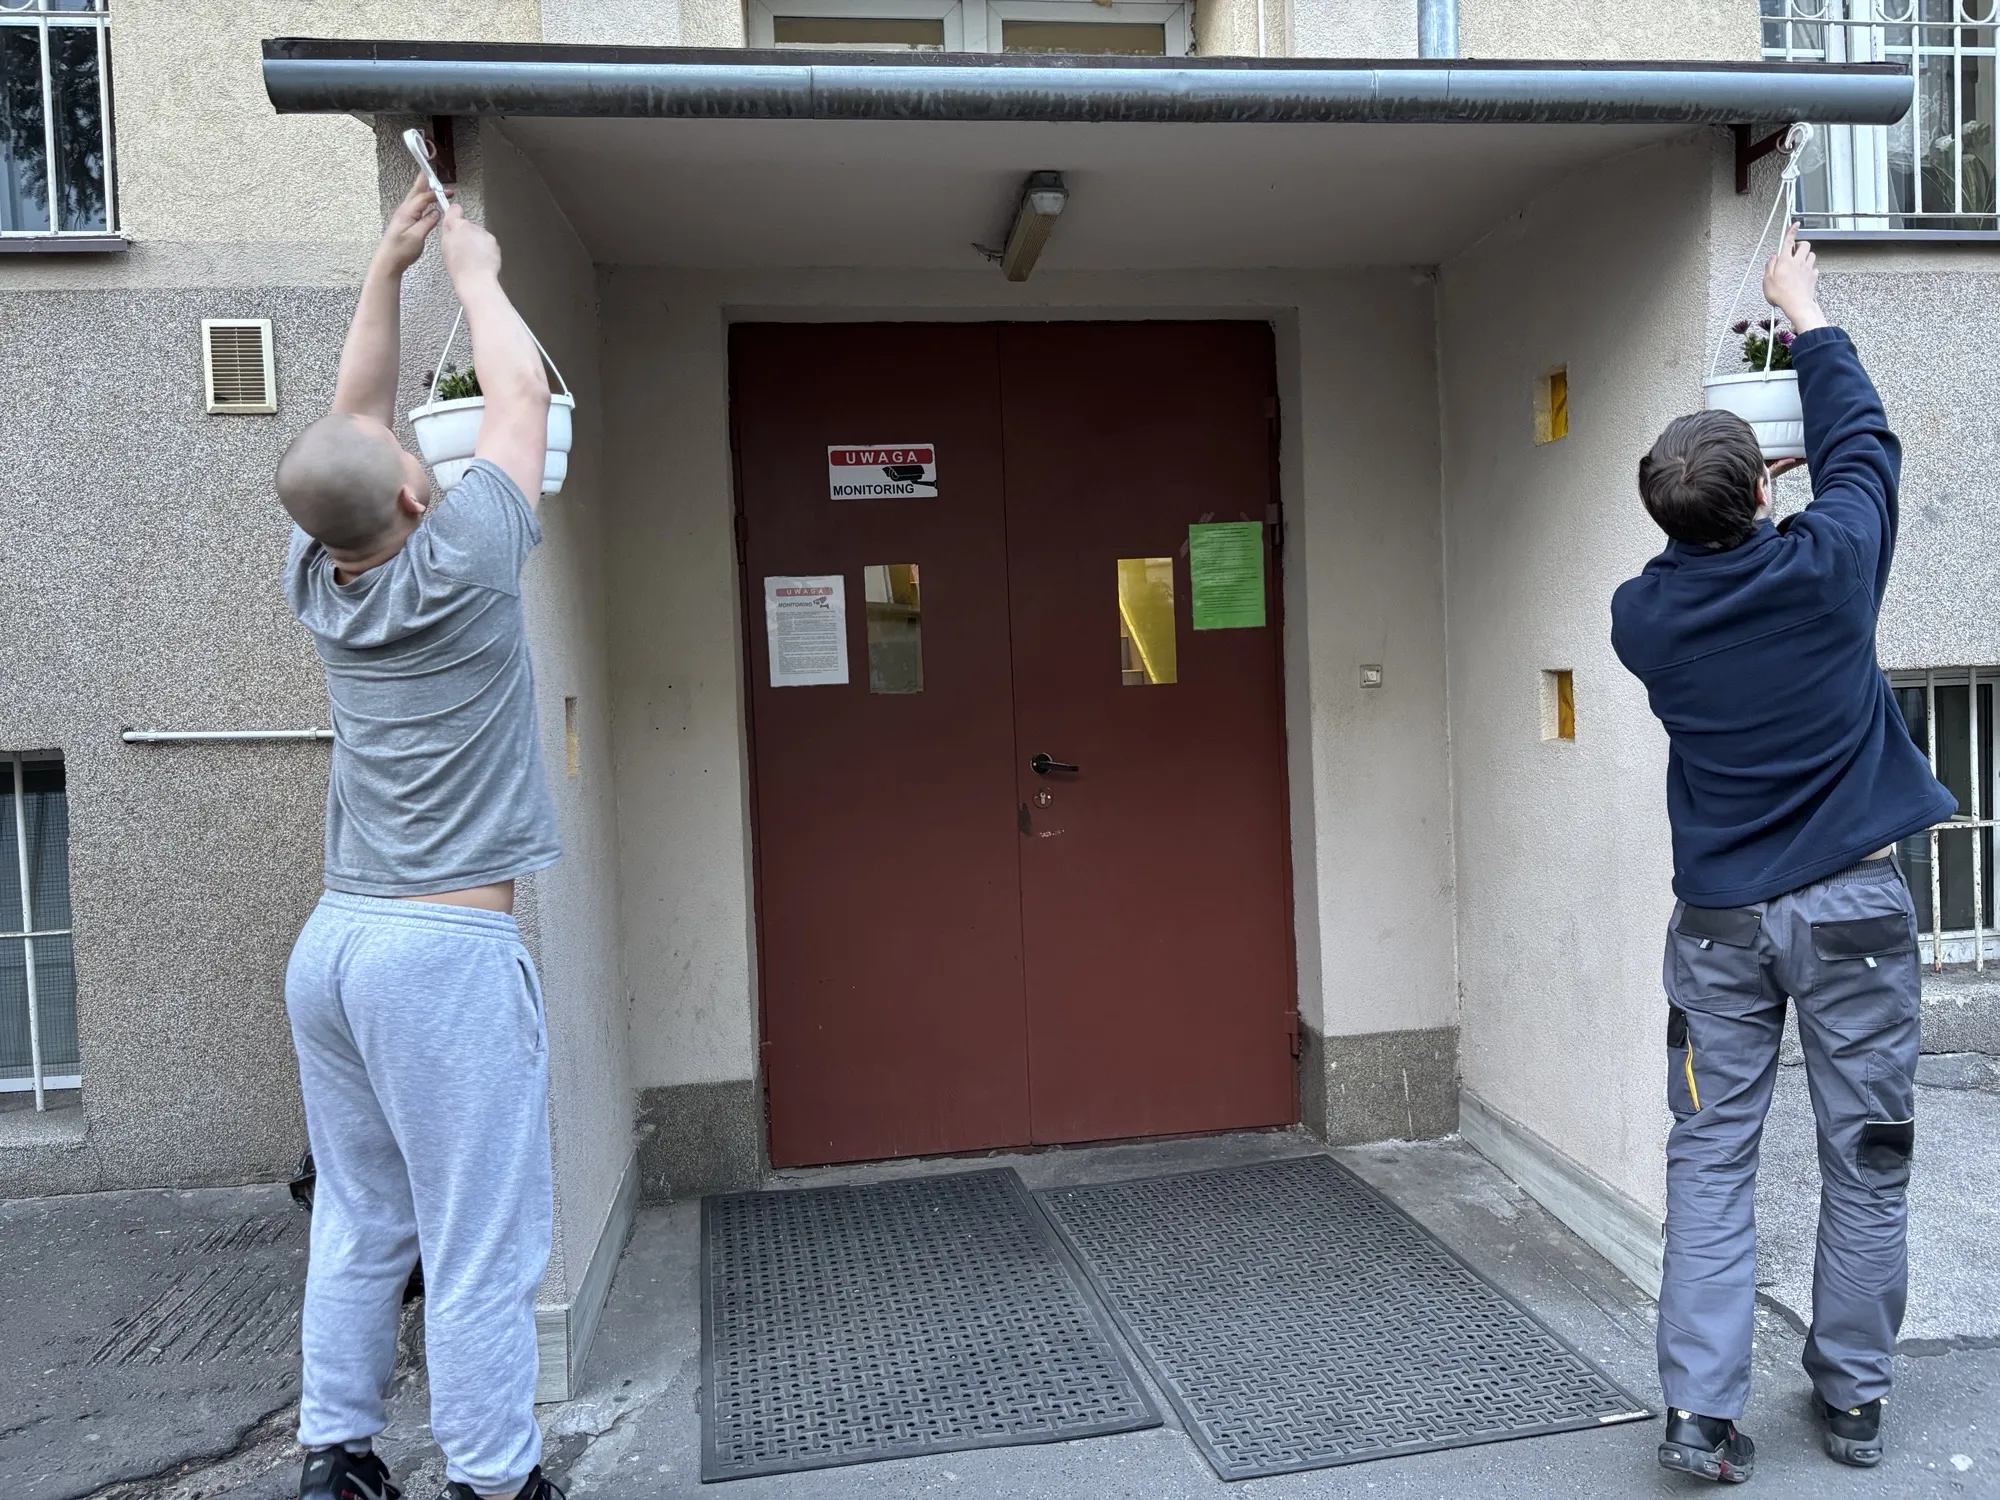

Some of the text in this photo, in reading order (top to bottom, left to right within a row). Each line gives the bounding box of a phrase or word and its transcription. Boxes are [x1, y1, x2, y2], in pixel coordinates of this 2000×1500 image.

[846, 451, 918, 464] UWAGA
[833, 483, 914, 496] MONITORING
[786, 588, 824, 596] UWAGA
